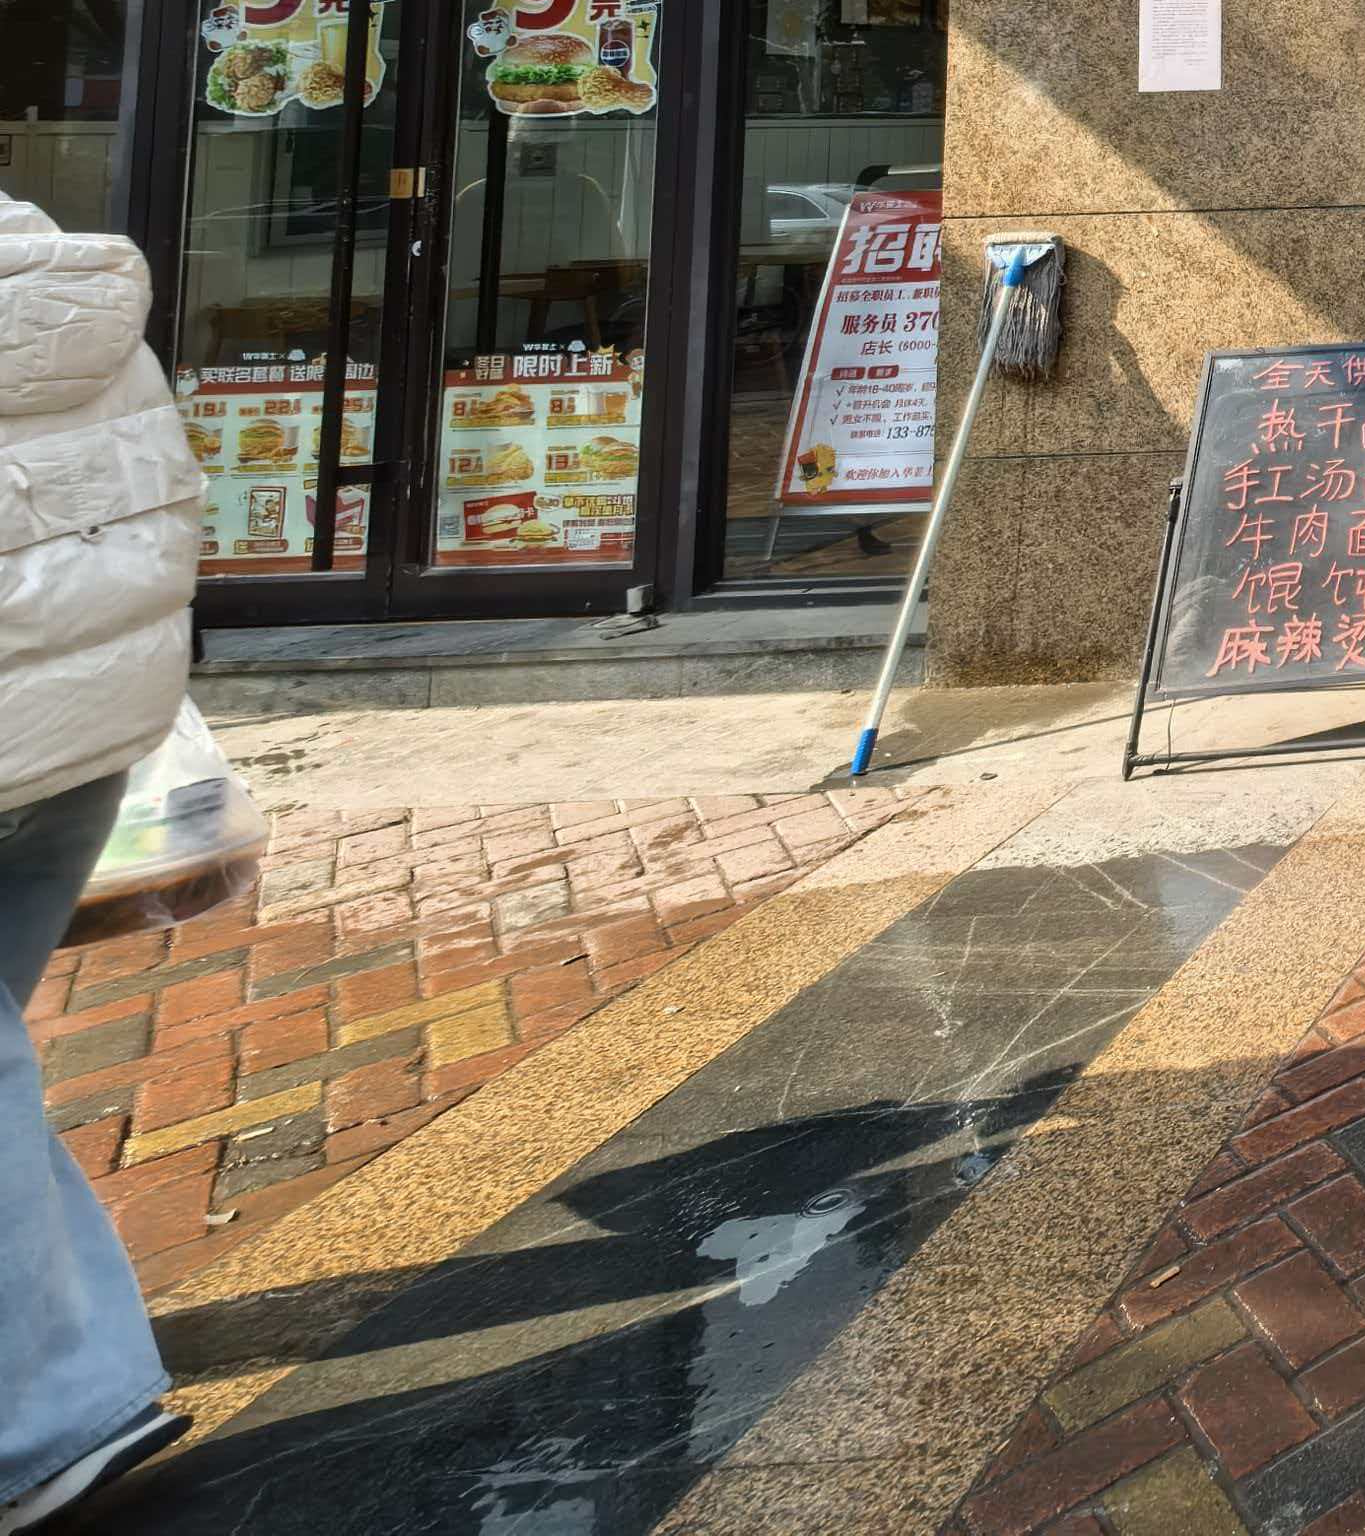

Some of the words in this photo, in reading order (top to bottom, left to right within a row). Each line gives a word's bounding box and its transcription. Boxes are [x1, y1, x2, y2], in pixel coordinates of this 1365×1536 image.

[840, 313, 897, 335] 服务员
[861, 340, 893, 356] 店长
